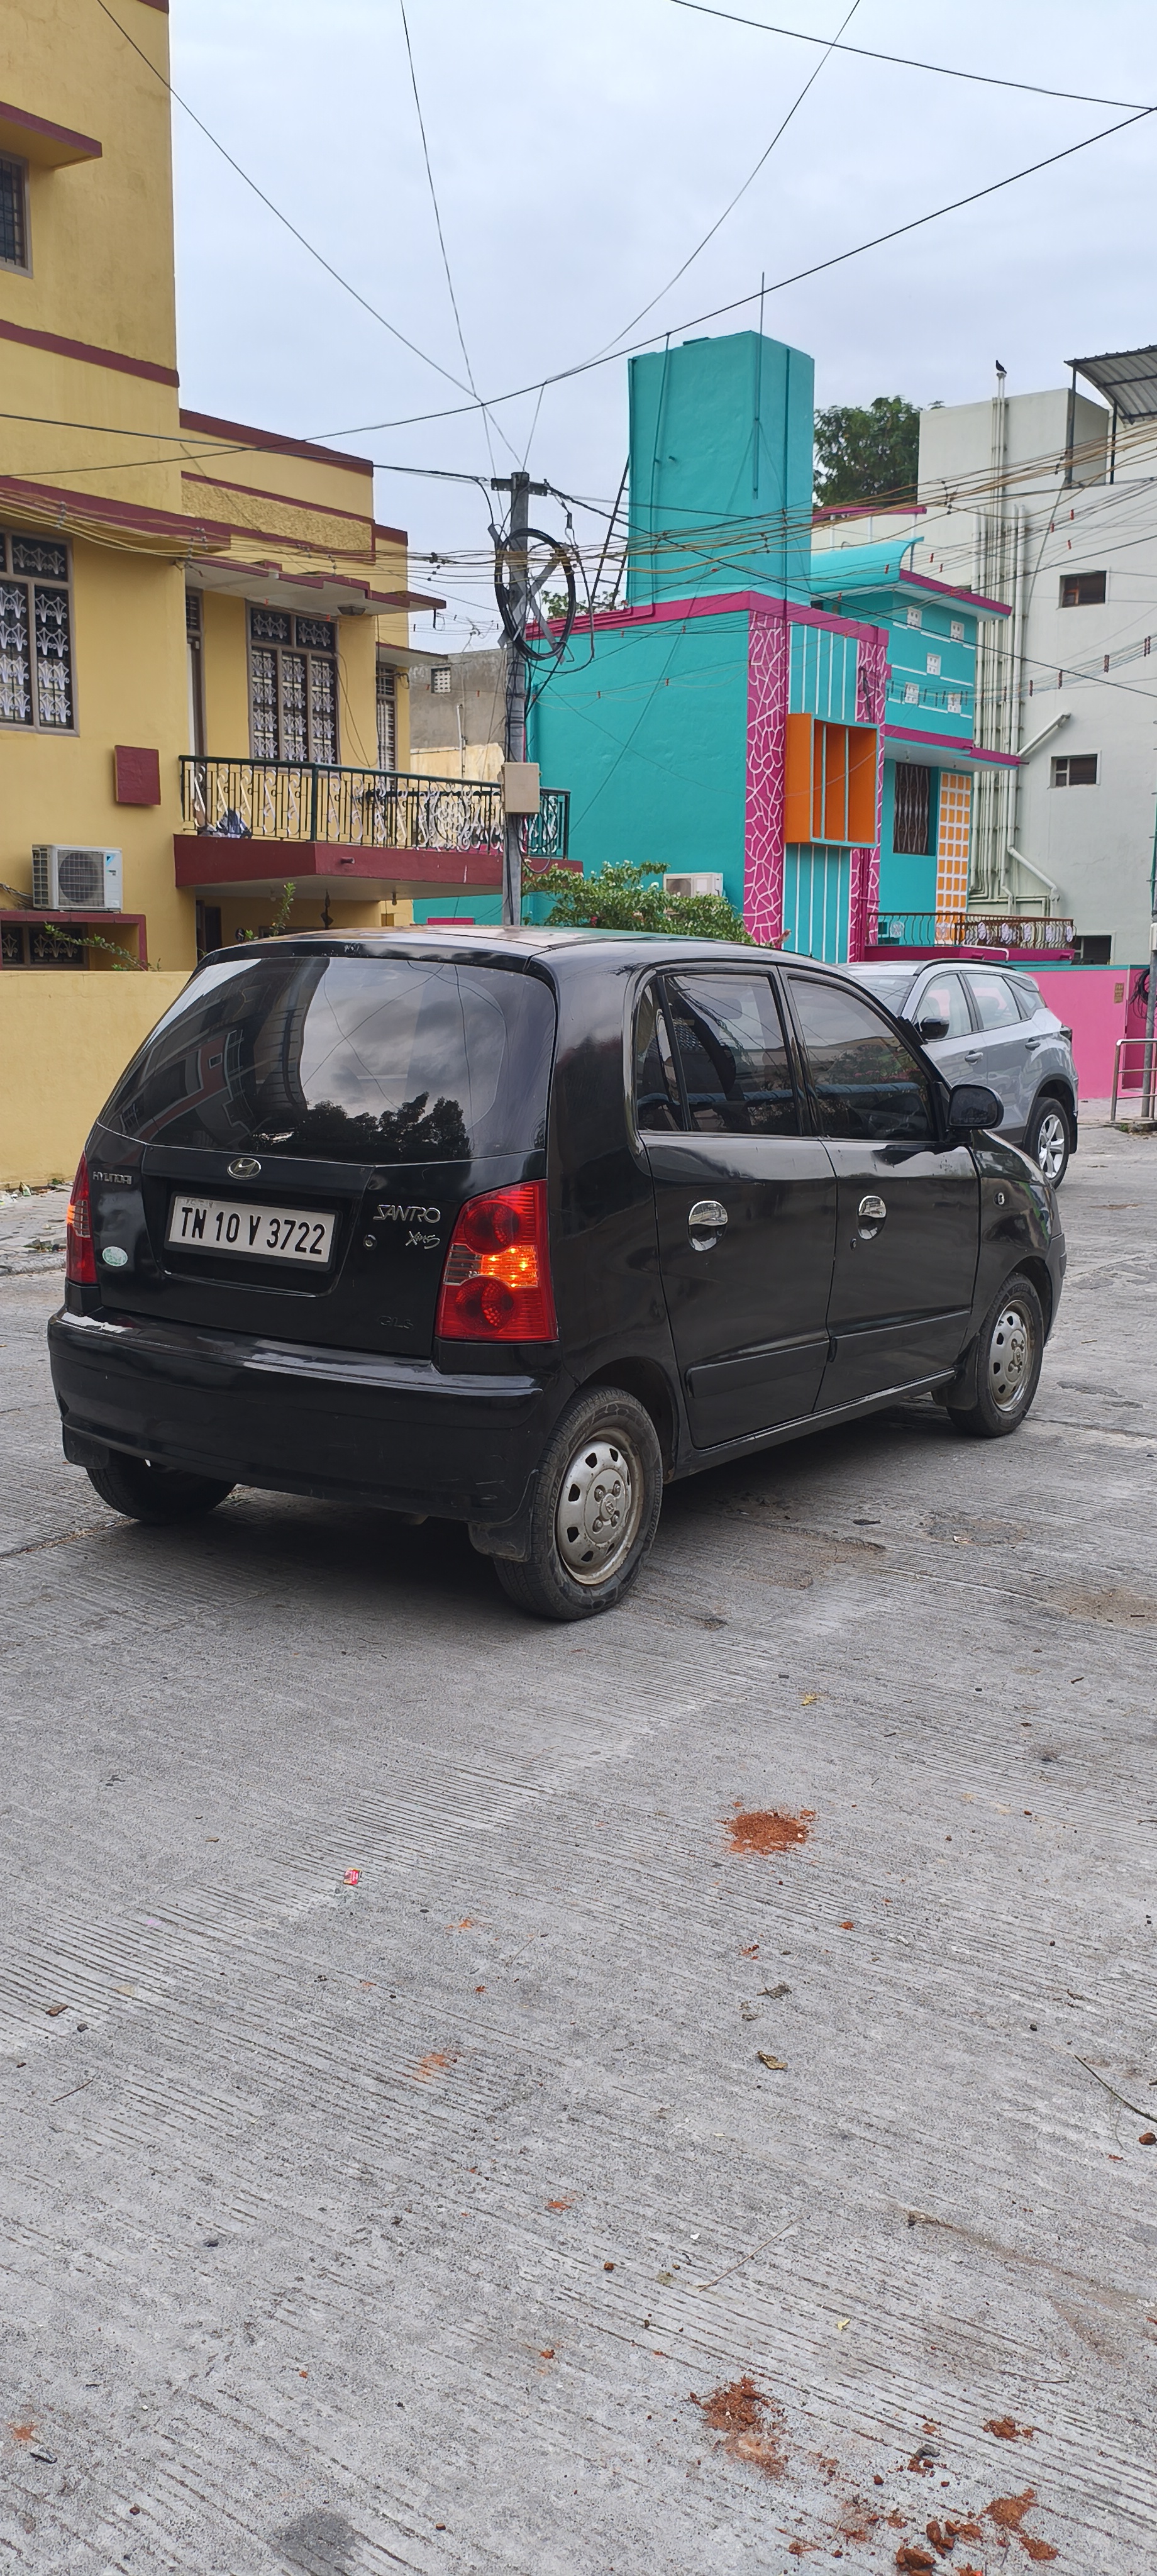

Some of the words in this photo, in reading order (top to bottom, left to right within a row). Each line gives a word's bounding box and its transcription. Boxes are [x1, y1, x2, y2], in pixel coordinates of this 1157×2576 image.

[92, 1172, 132, 1185] HYUNDAI
[373, 1204, 441, 1223] SANTRO
[182, 1207, 207, 1239] TN
[216, 1211, 241, 1243] 10
[249, 1214, 262, 1246] V
[266, 1218, 326, 1255] 3722
